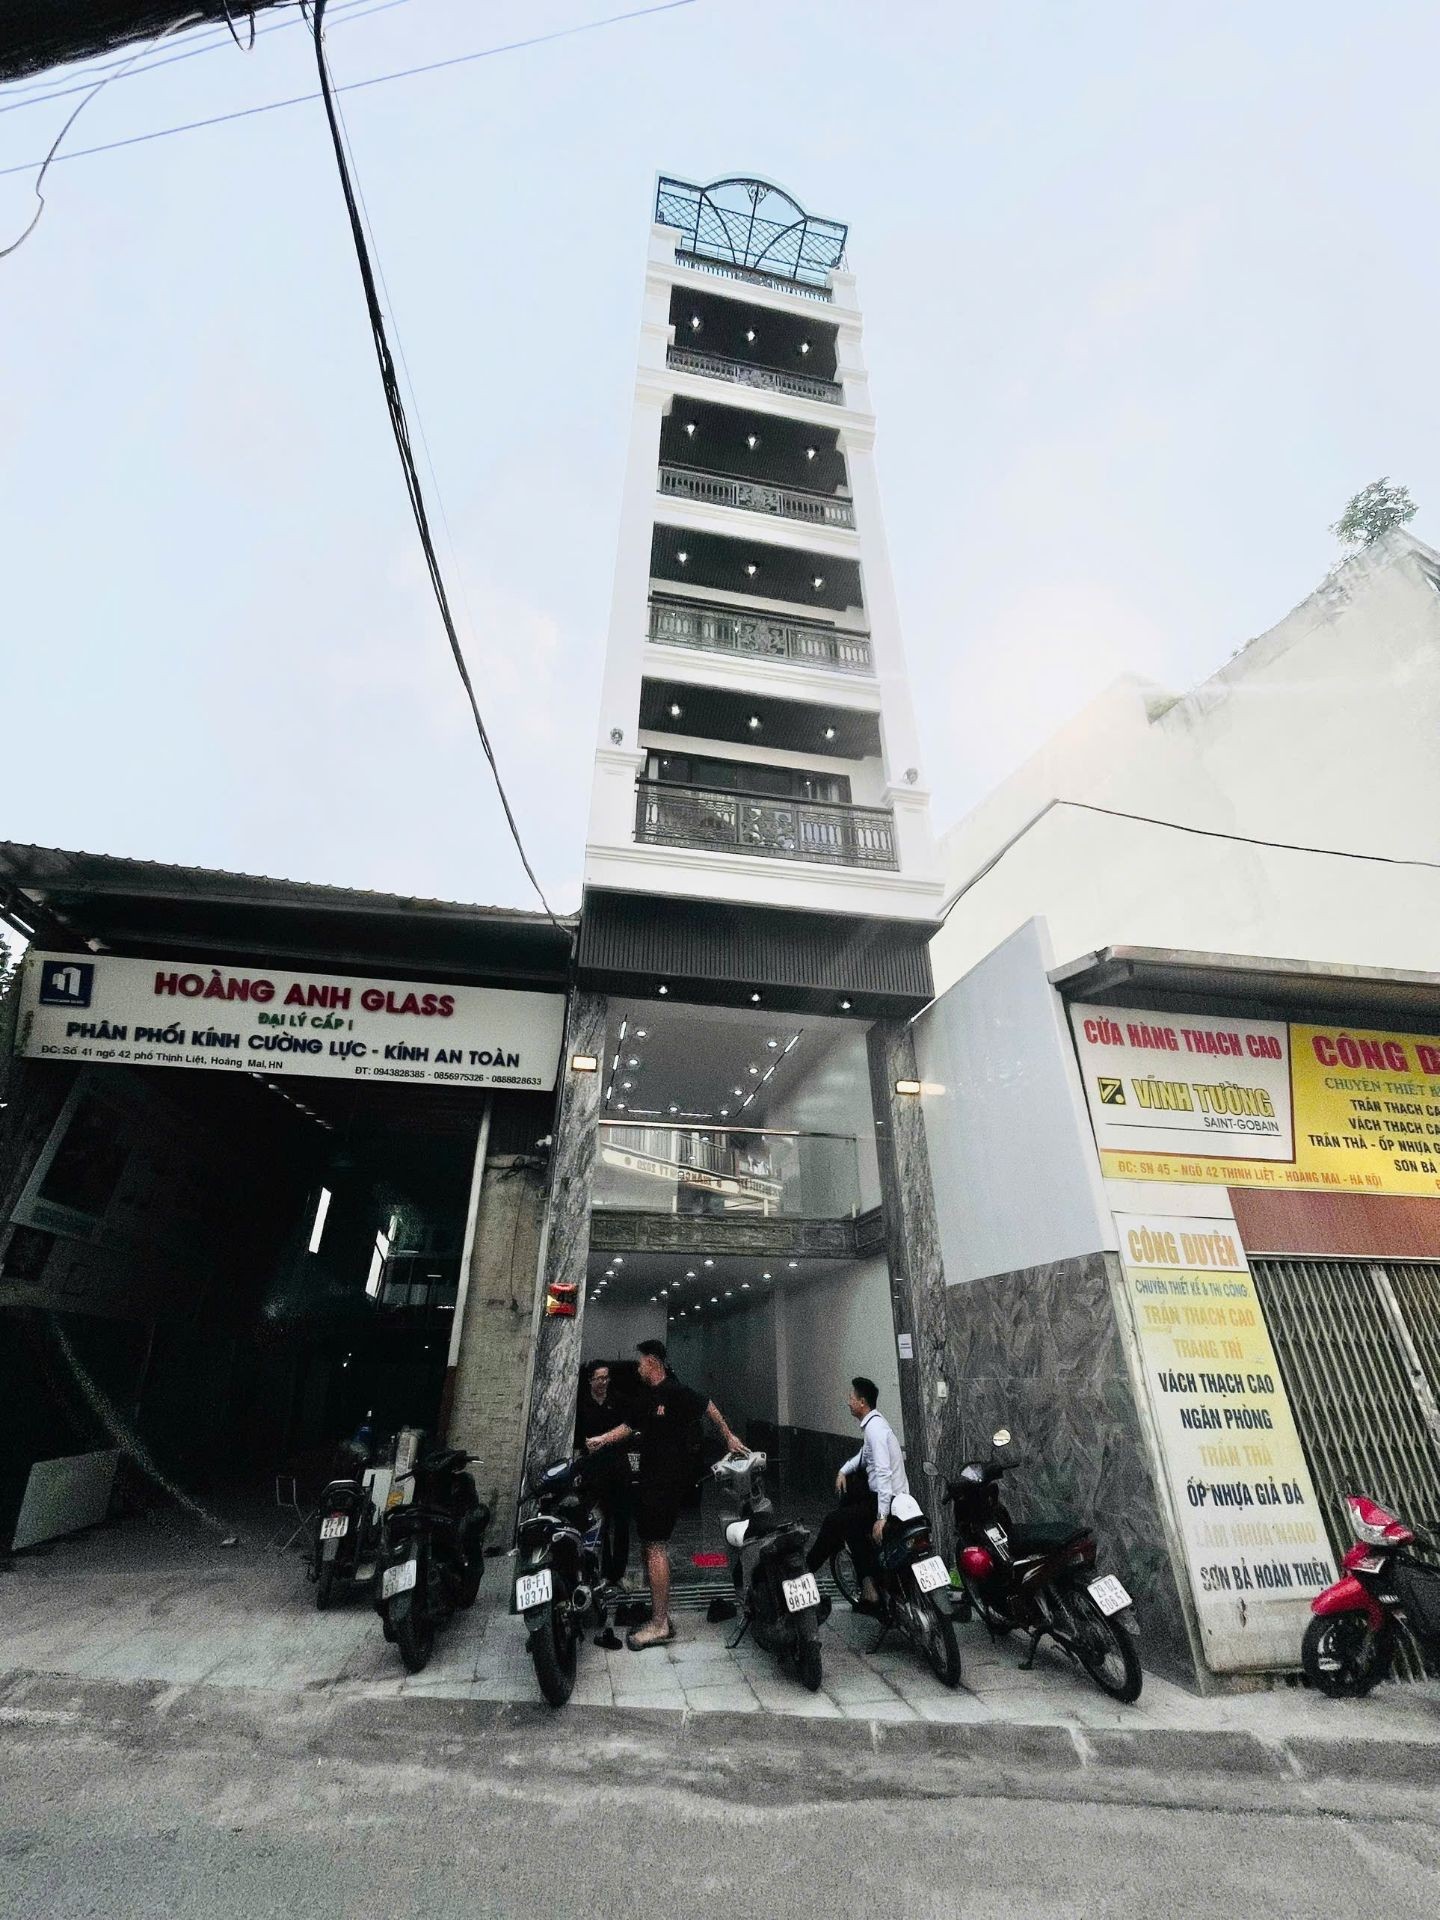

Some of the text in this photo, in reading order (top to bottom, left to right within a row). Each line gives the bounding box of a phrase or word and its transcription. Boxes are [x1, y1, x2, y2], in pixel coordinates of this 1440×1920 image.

[154, 969, 456, 1017] HOÀNG ANH GLASS
[258, 1012, 285, 1029] ĐẠI
[289, 1010, 307, 1028] LÝ
[311, 1011, 344, 1031] CẤP
[66, 1020, 127, 1040] PHÂN
[134, 1021, 185, 1046] PHỐI
[192, 1027, 240, 1048] KÍNH
[248, 1031, 323, 1054] CƯỜNG
[329, 1039, 367, 1060] LỰC
[384, 1041, 429, 1062] KÍNH
[435, 1049, 463, 1064] AN
[469, 1048, 519, 1068] TOÀN
[1083, 1016, 1283, 1060] CỬA HÀNG THẠCH CAO
[41, 1045, 60, 1055] ĐC:
[62, 1046, 78, 1055] Số
[81, 1048, 92, 1056] 41
[118, 1050, 130, 1059] 42
[157, 1053, 183, 1063] Thịnh
[269, 1061, 283, 1069] HN
[1311, 1032, 1411, 1073] CÔNG
[355, 1066, 371, 1075] ĐT:
[373, 1067, 425, 1079] 0943828385
[1131, 1074, 1275, 1117] VĨNH TƯỜNG
[1325, 1077, 1382, 1093] CHUYÊN
[1384, 1102, 1423, 1117] THẠCH
[1204, 1116, 1279, 1132] SAINT-GOBAIN
[1348, 1115, 1381, 1131] VÁCH
[1383, 1120, 1423, 1136] THẠCH
[1379, 1134, 1394, 1151] ỐP
[1399, 1139, 1432, 1156] NHỰA
[1157, 1163, 1170, 1175] 45
[1206, 1166, 1219, 1178] 42
[1321, 1172, 1341, 1185] MAI
[1127, 1225, 1240, 1266] CÔNG DUYÊN
[1135, 1277, 1168, 1295] CHUYÊN
[1168, 1275, 1189, 1295] THIẾT
[1228, 1307, 1256, 1327] CAO
[1173, 1338, 1219, 1359] TRANG
[1158, 1368, 1275, 1398] VÁCH THẠCH CAO
[1180, 1404, 1273, 1429] NGĂN PHÒNG
[1187, 1476, 1305, 1510] ỐP NHỰA GIẢ ĐÁ
[1200, 1557, 1332, 1591] SƠN BẢ HOÀN THIỆN
